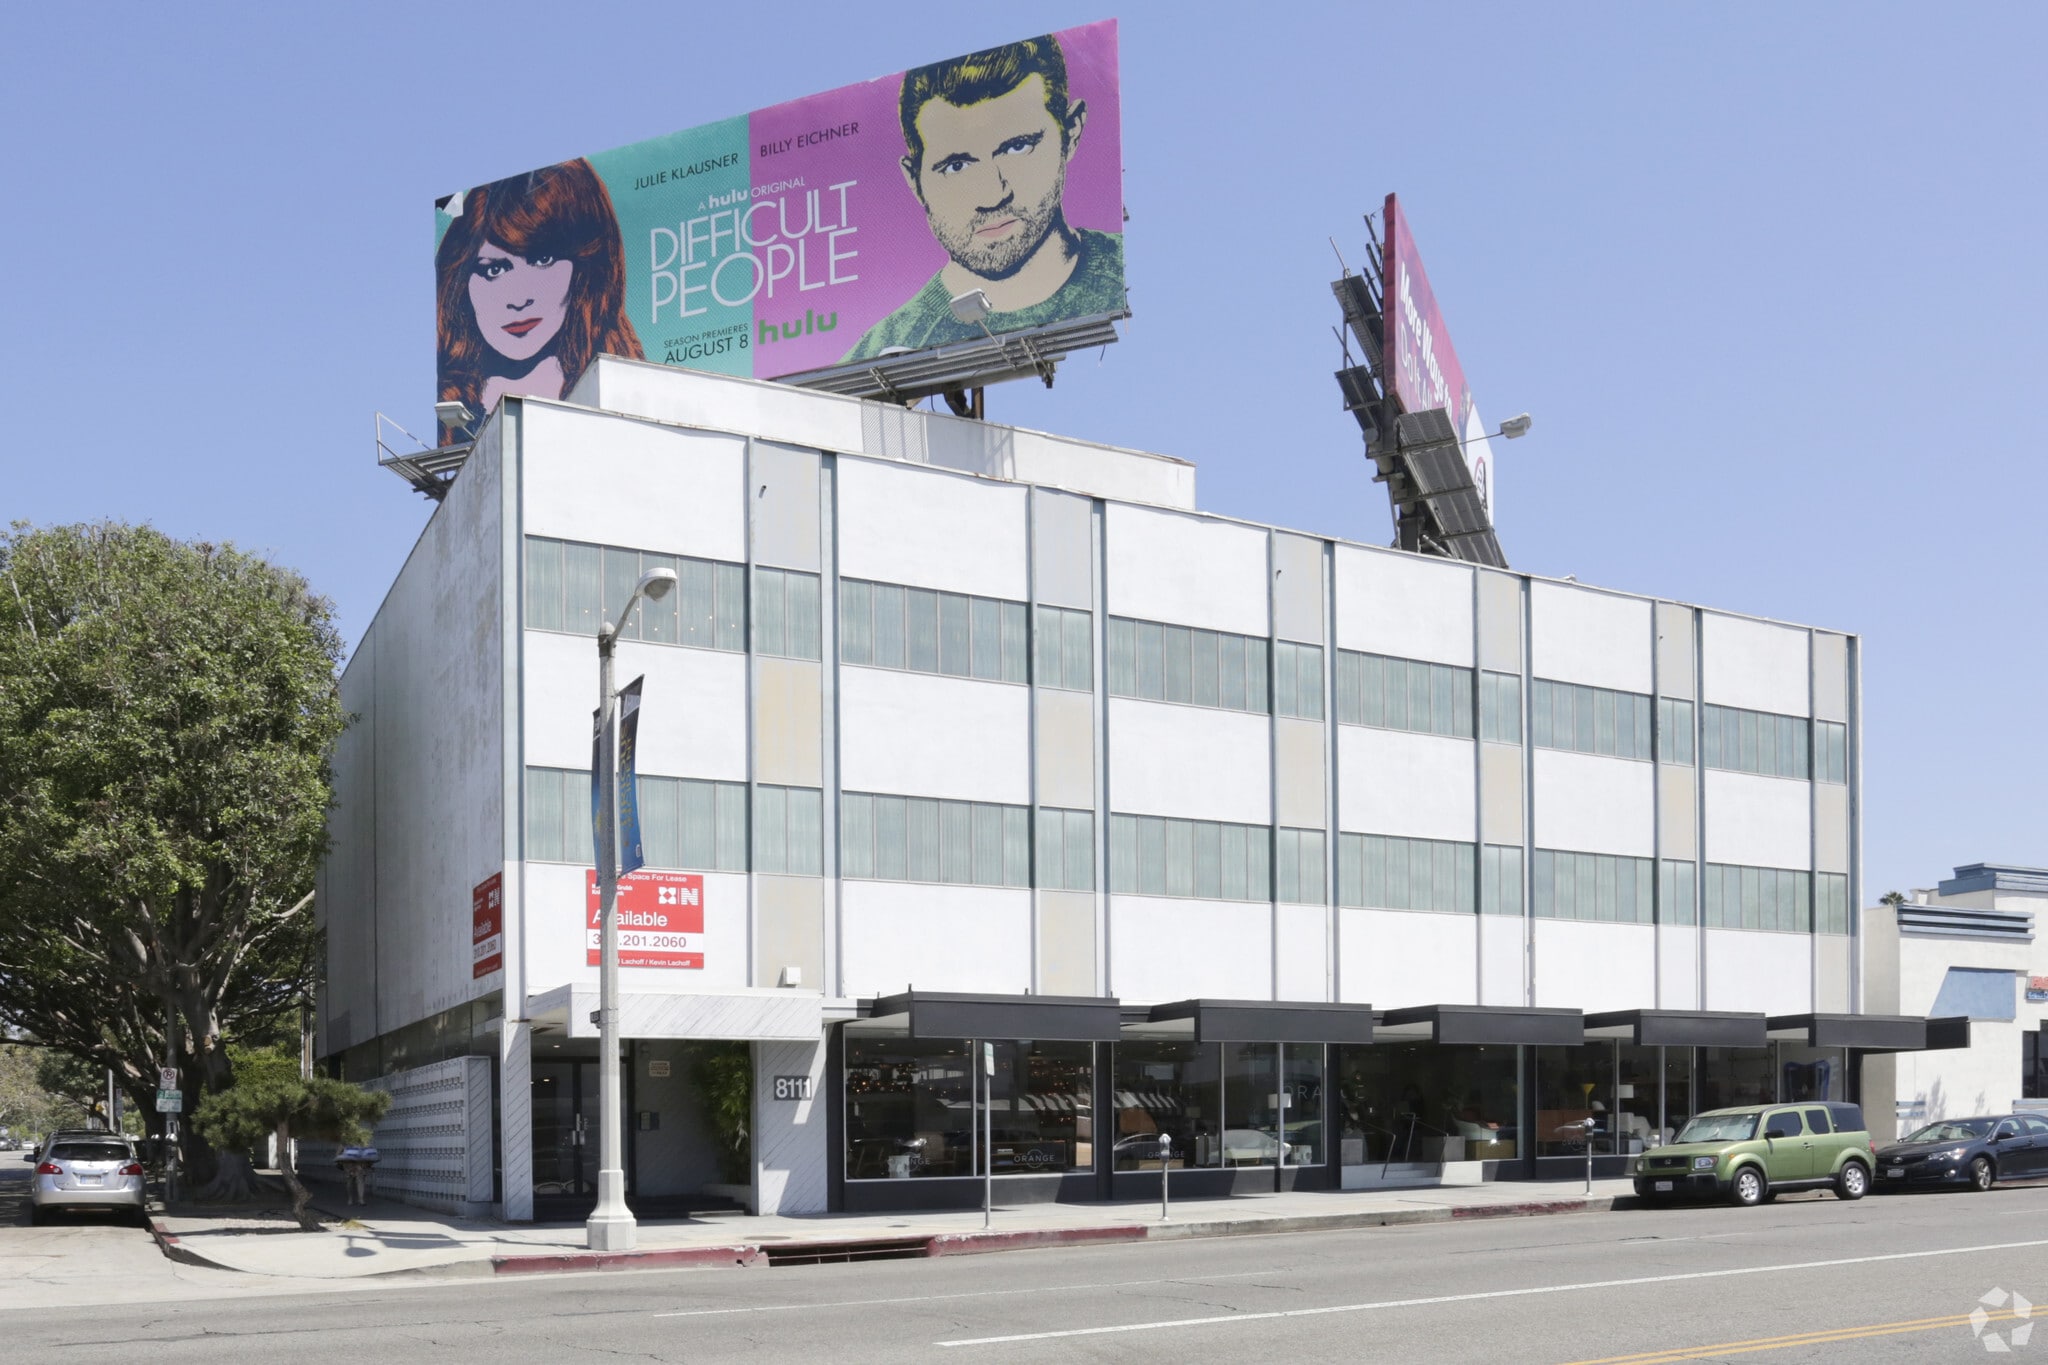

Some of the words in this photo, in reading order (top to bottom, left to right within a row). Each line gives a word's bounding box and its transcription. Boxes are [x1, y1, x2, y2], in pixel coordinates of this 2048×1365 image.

[760, 138, 792, 157] BILLY
[797, 122, 859, 148] EICHNER
[634, 171, 667, 190] JULIE
[672, 153, 738, 180] KLAUSNER
[697, 202, 706, 212] A
[709, 189, 748, 209] hulu
[751, 176, 805, 197] ORIGINAL
[651, 180, 858, 272] DIFFICULT
[652, 227, 859, 324] PEOPLE
[664, 334, 700, 349] SEASON
[702, 323, 748, 340] PREMIERES
[758, 309, 837, 345] hulu
[1400, 262, 1422, 347] More
[1422, 319, 1445, 403] Ways
[664, 337, 733, 364] AUGUST
[739, 334, 749, 349] 8
[627, 873, 650, 882] Space
[665, 875, 687, 883] Lease
[592, 909, 668, 926] Aailable
[593, 933, 687, 948] 3.201.2060
[776, 1078, 811, 1099] 8111
[1013, 1154, 1056, 1163] ORANGE
